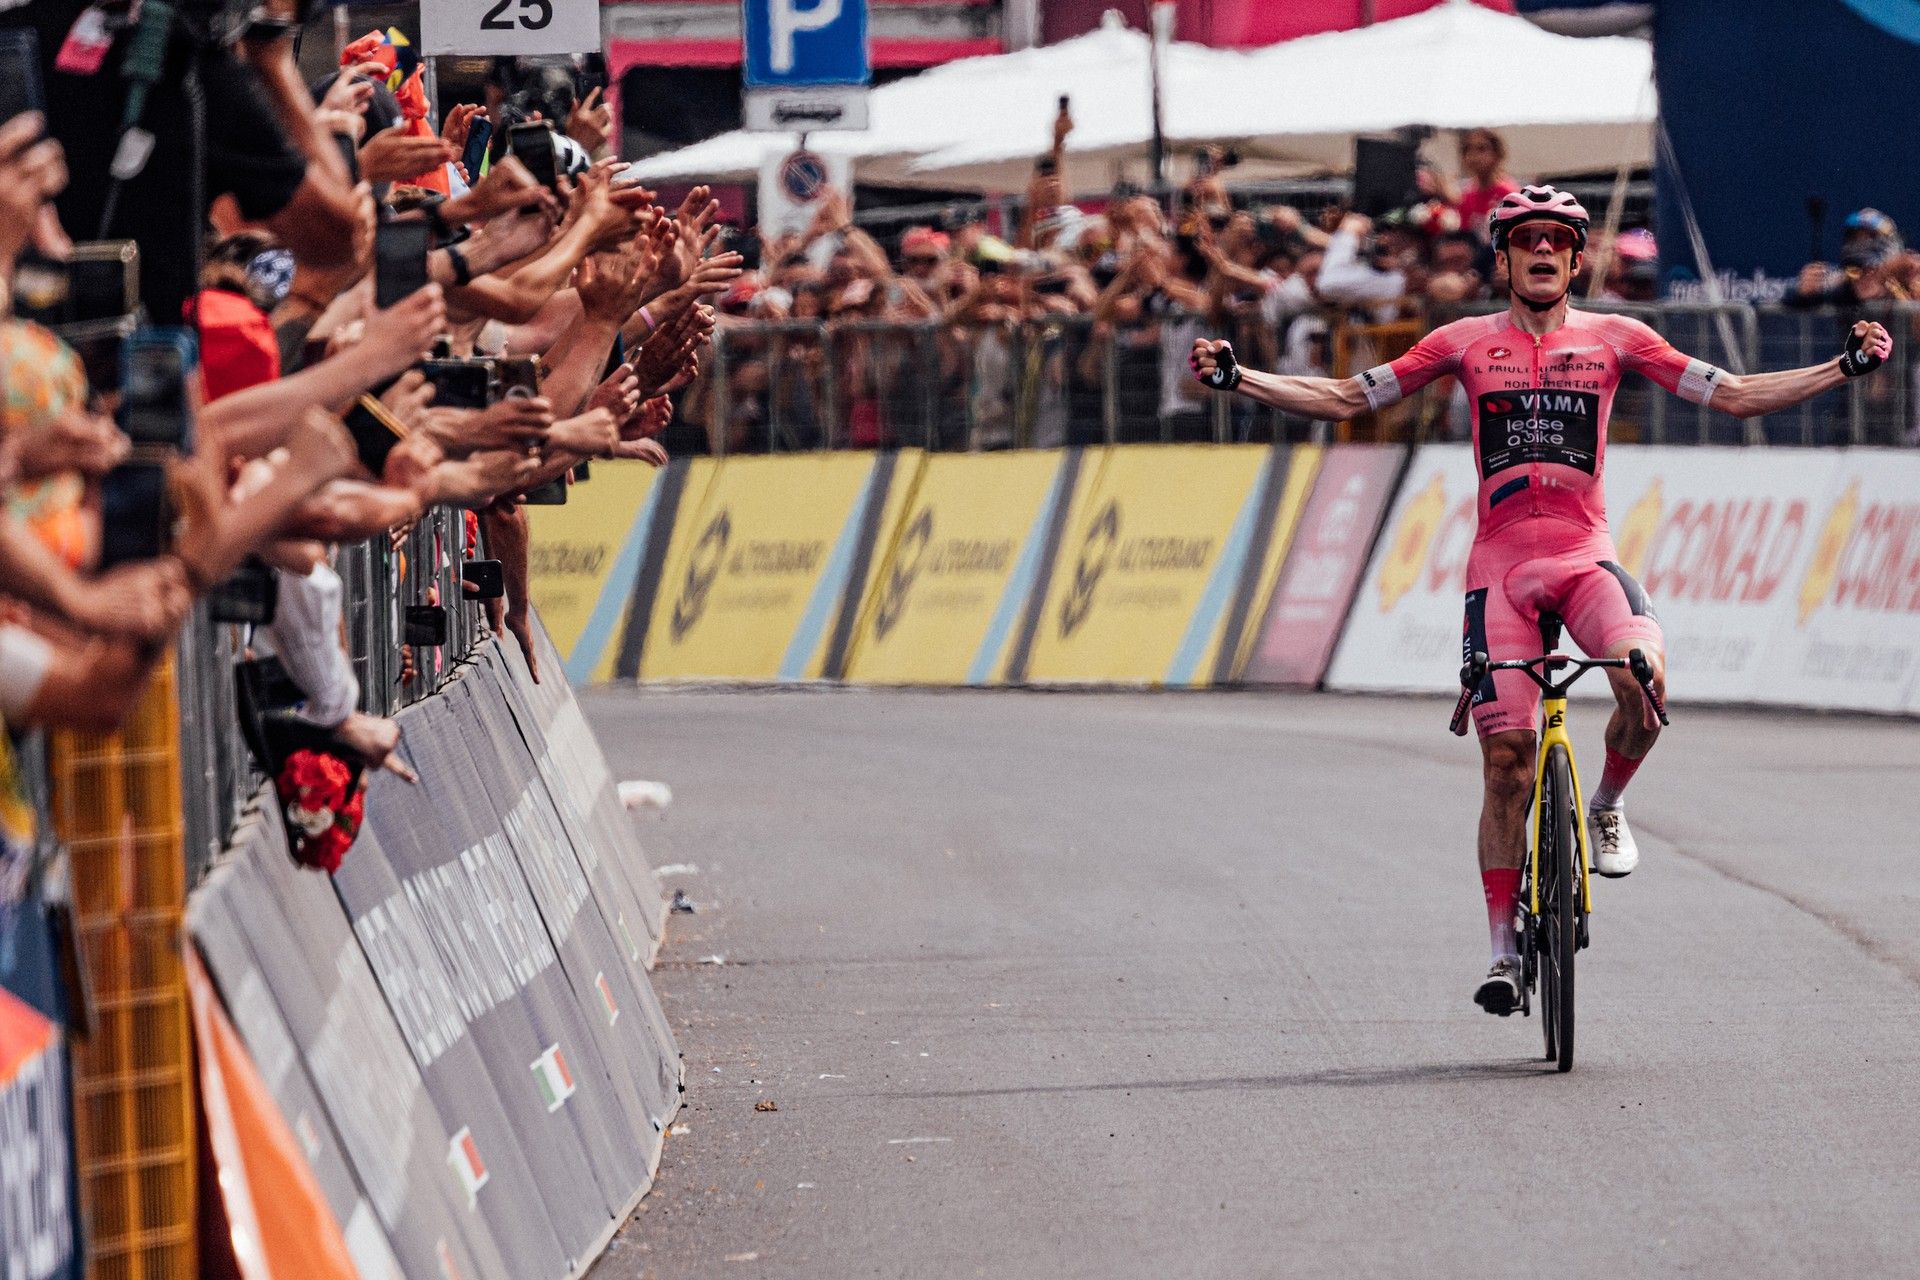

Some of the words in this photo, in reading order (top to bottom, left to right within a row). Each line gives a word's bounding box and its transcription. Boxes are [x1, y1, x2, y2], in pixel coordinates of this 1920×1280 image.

[480, 0, 553, 30] 25
[769, 0, 843, 74] P
[1488, 364, 1529, 374] FRIULI
[1504, 379, 1531, 389] NON
[1520, 394, 1587, 416] VISMA
[1506, 418, 1565, 433] lease
[1507, 434, 1521, 447] a
[1645, 496, 1808, 602] CONAD
[1834, 500, 1920, 612] CONA
